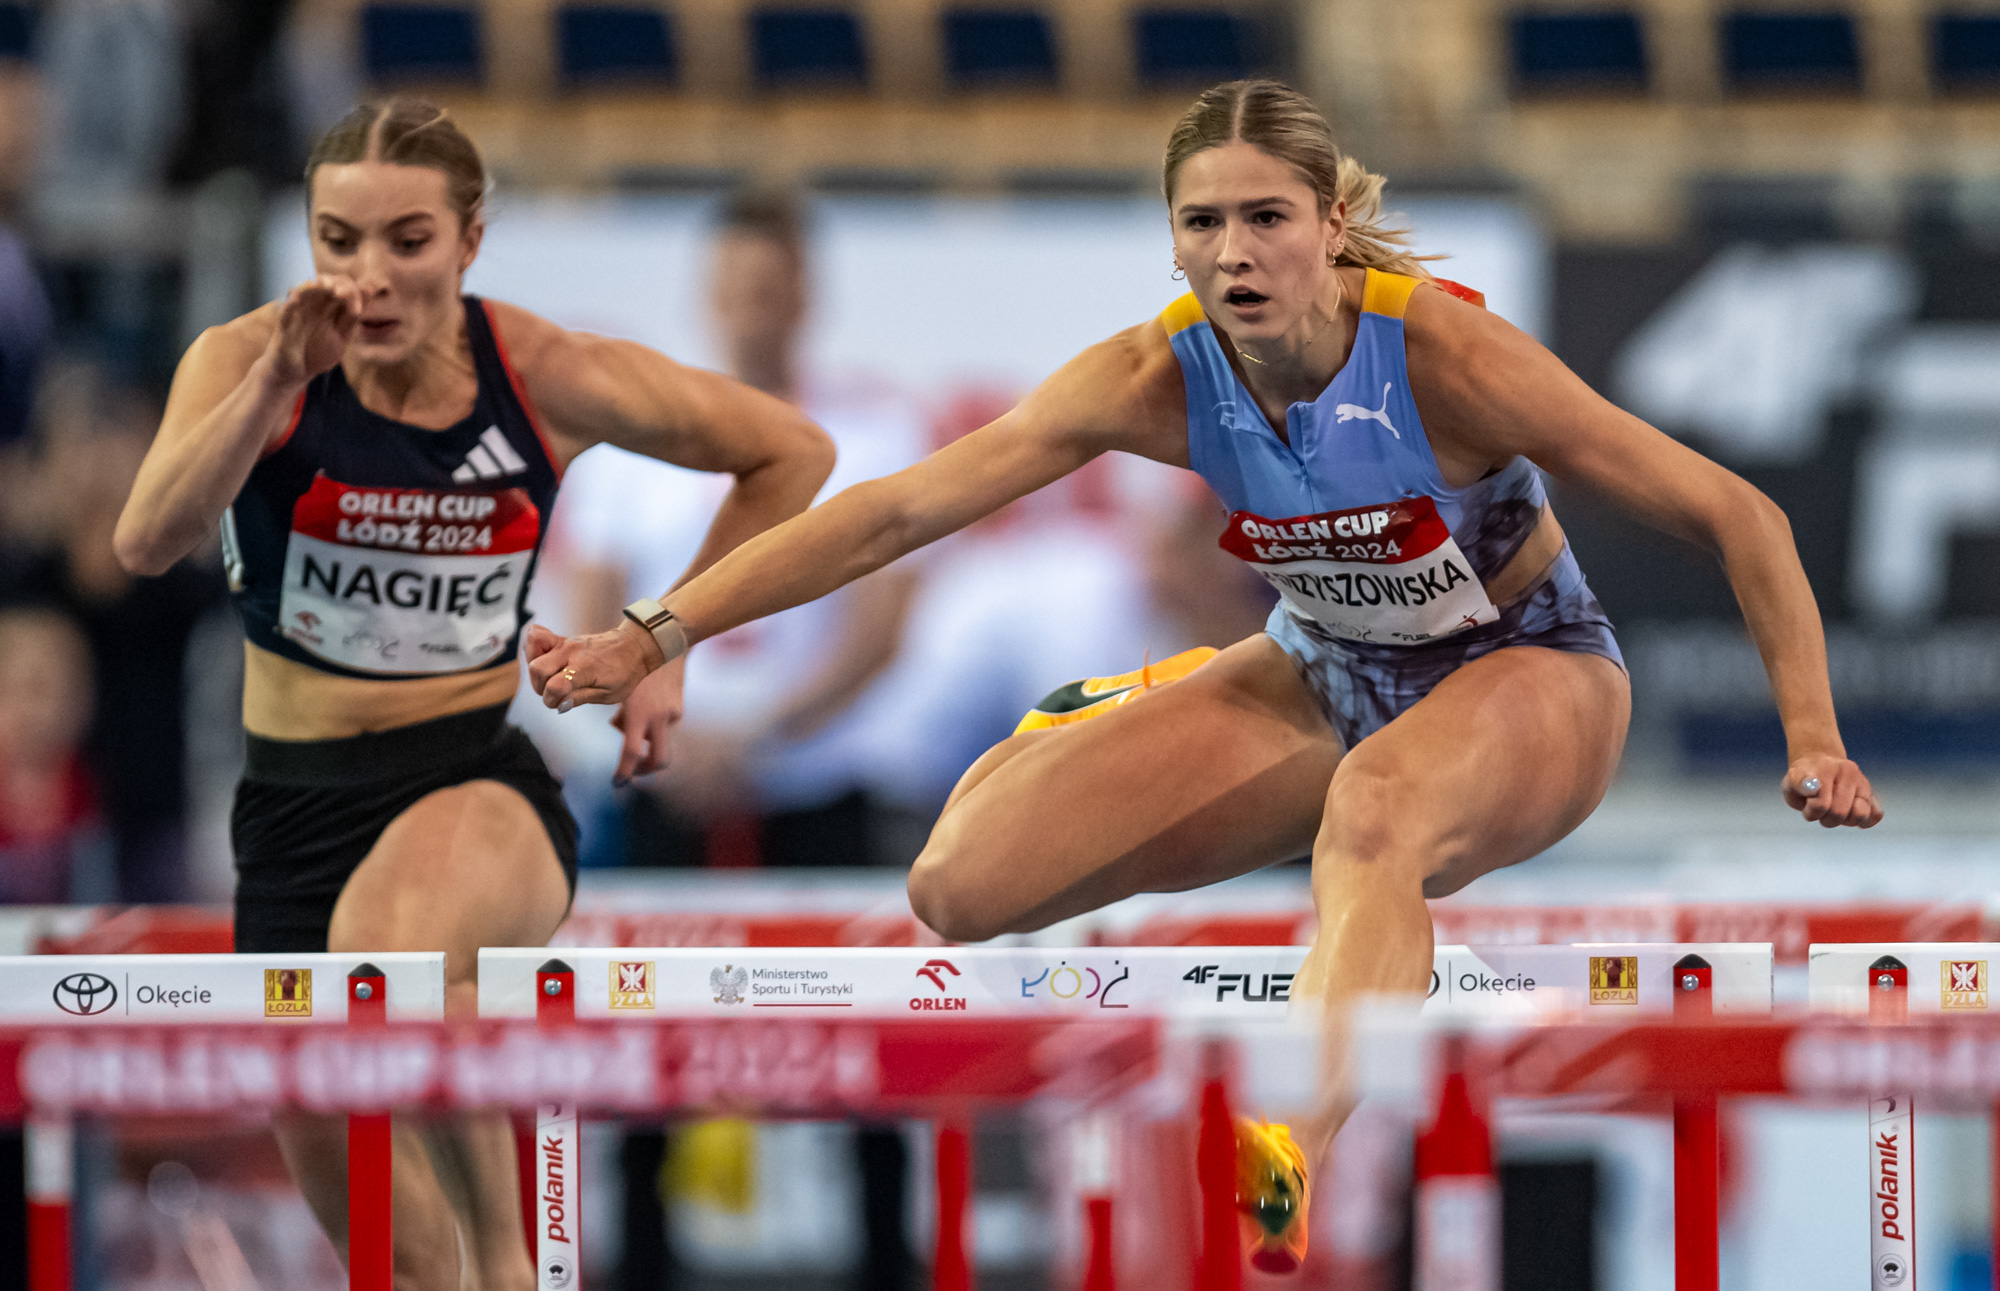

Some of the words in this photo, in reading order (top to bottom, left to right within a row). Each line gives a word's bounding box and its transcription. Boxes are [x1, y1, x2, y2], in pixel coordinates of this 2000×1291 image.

[338, 491, 432, 519] ORLEN
[438, 493, 496, 520] CUP
[336, 517, 422, 549] ŁÓDŹ
[425, 524, 493, 551] 2024
[1240, 518, 1332, 541] ORLEN
[1333, 511, 1390, 536] CUP
[1252, 541, 1335, 559] ŁÓDŹ
[1338, 539, 1403, 560] 2024
[301, 553, 510, 617] NAGIĘĆ
[752, 968, 829, 980] Ministerstwo
[1182, 965, 1219, 984] 4F
[1215, 973, 1296, 1002] FUE
[1459, 971, 1537, 995] Okęcie
[136, 984, 212, 1009] Okęcie
[609, 992, 654, 1010] PZLA
[752, 983, 790, 996] Sportu
[800, 983, 853, 996] Turystyki
[1592, 989, 1636, 1001] ŁOZLA
[1942, 992, 1988, 1009] PZLA
[267, 1001, 310, 1014] ŁOZLA
[909, 998, 967, 1011] ORLEN
[542, 1135, 571, 1244] polanik
[1875, 1131, 1906, 1242] polanik
